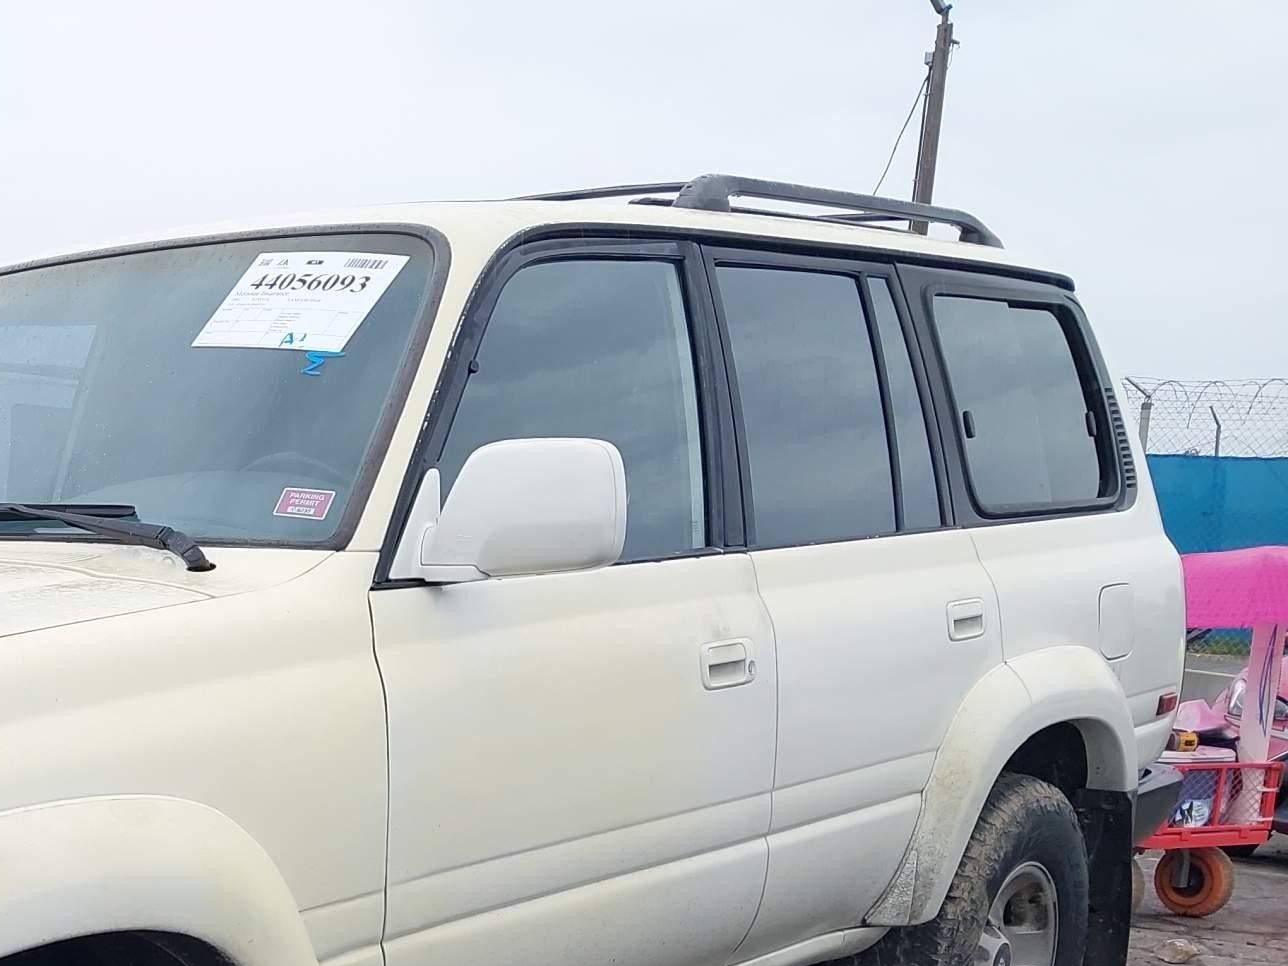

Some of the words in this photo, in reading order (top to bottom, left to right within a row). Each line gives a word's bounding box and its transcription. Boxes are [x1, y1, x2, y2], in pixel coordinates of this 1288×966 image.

[250, 272, 371, 293] 44056093
[289, 493, 325, 501] PARKING
[289, 498, 321, 506] PERMIT
